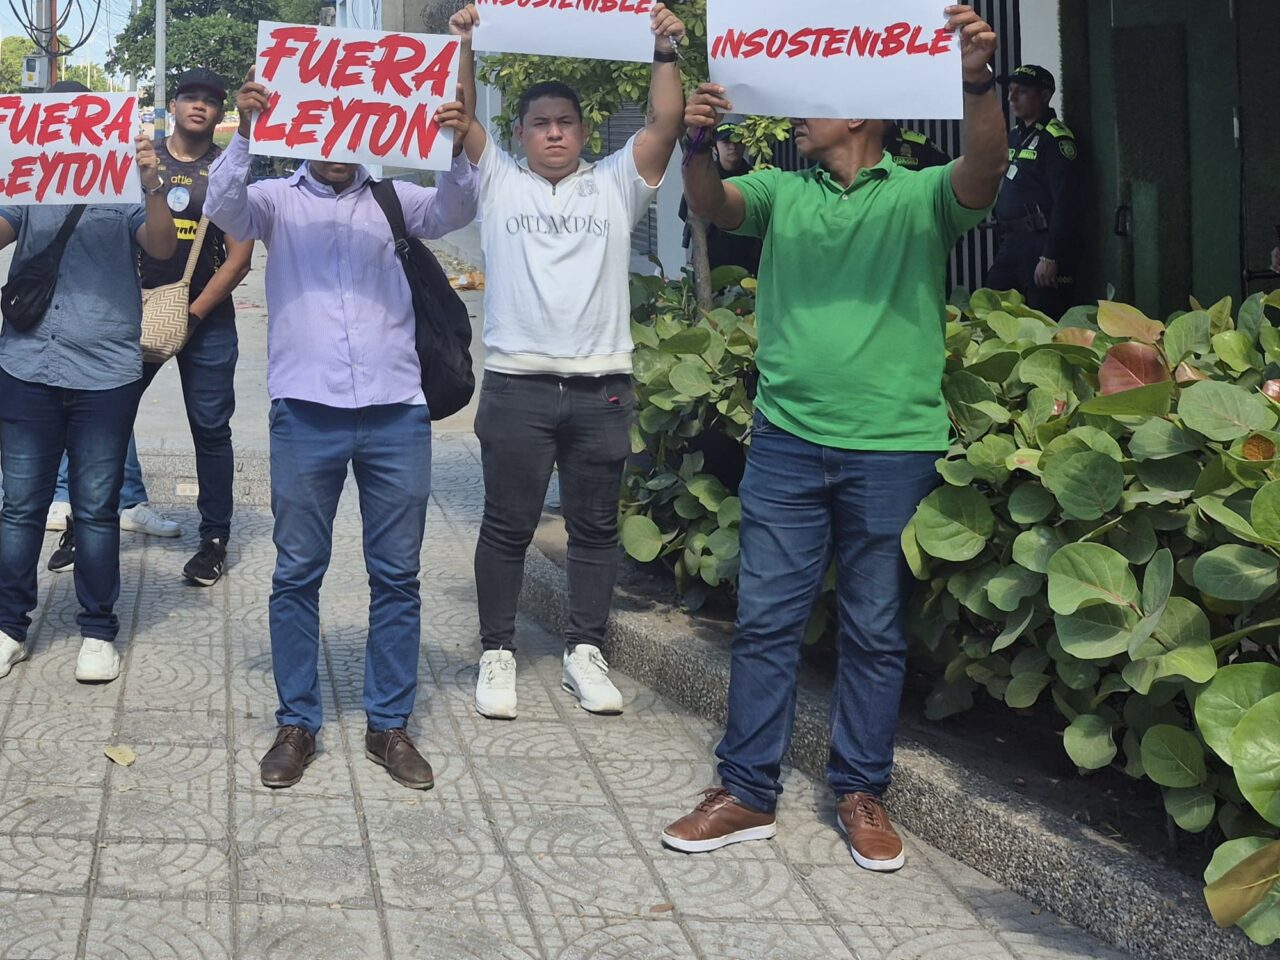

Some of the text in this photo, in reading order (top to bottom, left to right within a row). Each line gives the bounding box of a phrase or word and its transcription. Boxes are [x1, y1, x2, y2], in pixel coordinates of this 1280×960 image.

[261, 27, 458, 97] FUERA
[711, 22, 954, 59] INSOSTENIBLE
[255, 93, 438, 158] LEYTON
